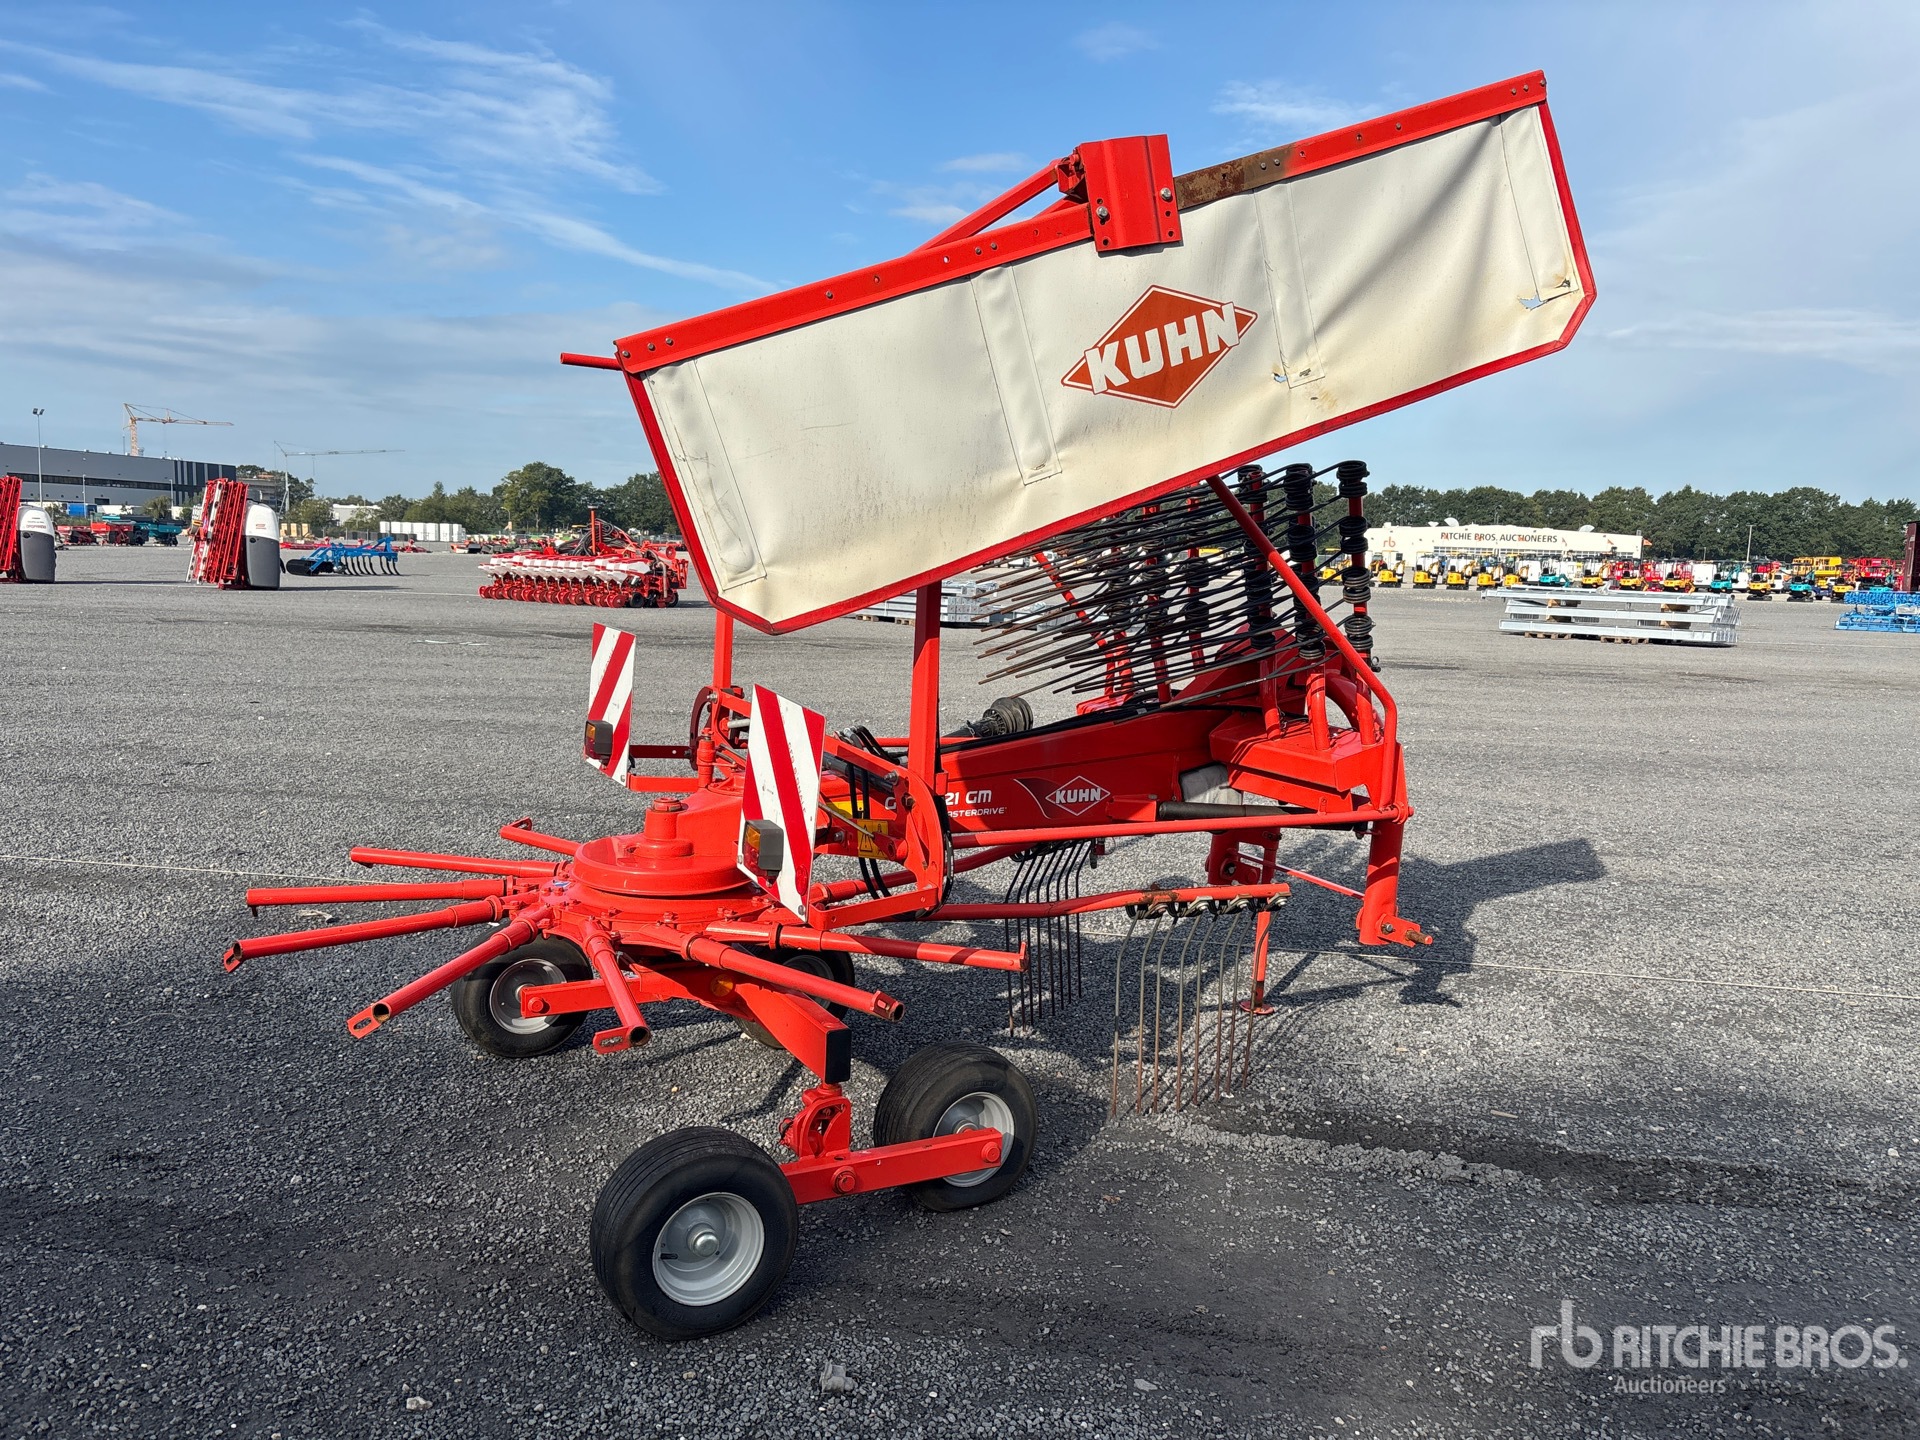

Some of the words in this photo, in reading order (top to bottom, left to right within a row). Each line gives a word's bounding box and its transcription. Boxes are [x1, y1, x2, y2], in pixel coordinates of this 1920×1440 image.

[1084, 301, 1240, 395] KUHN
[1382, 536, 1396, 548] rb
[1440, 532, 1472, 541] RITCHIE
[1500, 534, 1558, 543] AUCTIONEERS
[966, 790, 992, 804] GM
[1054, 787, 1101, 804] KUHN
[948, 807, 1004, 818] ASTERDRIVE
